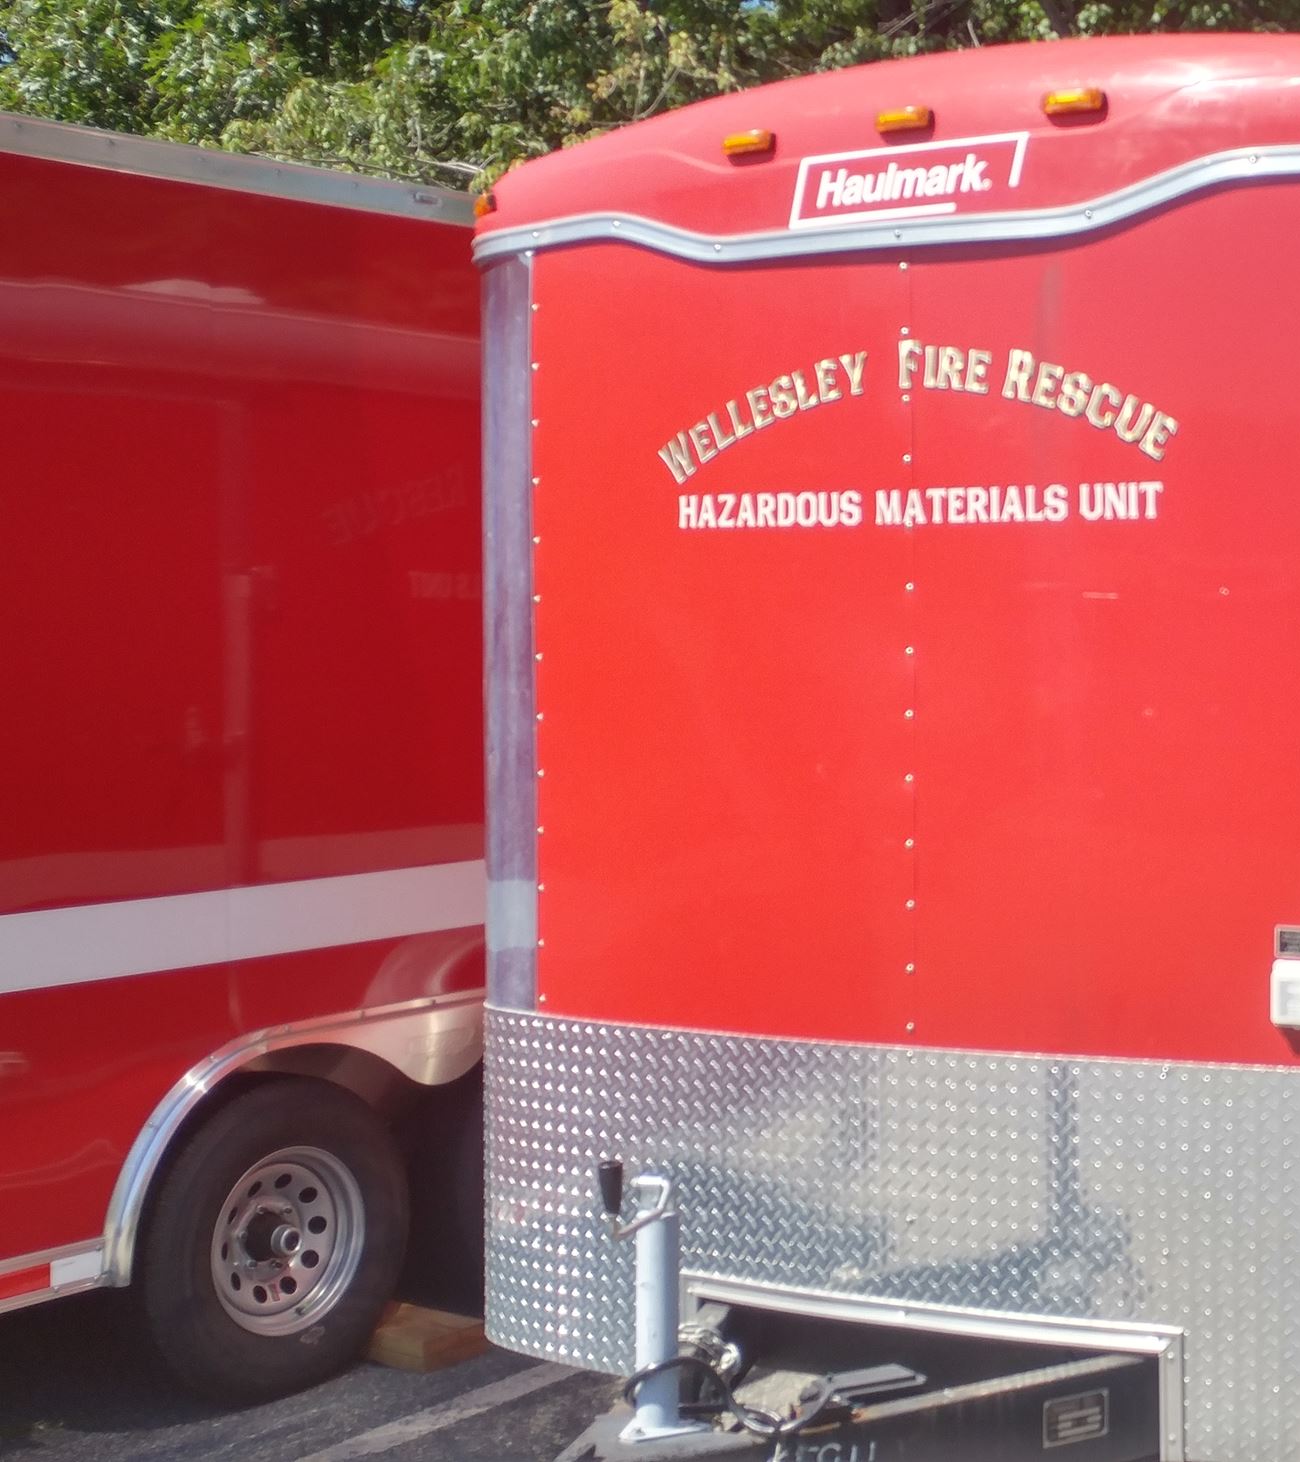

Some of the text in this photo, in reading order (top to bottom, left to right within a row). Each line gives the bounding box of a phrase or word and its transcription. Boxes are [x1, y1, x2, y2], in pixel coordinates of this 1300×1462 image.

[816, 153, 989, 209] Haulmark
[657, 338, 1180, 485] WELLESLEY FIRE RESCUE
[678, 481, 1164, 529] HAZARDOUS MATERIALS UNIT
